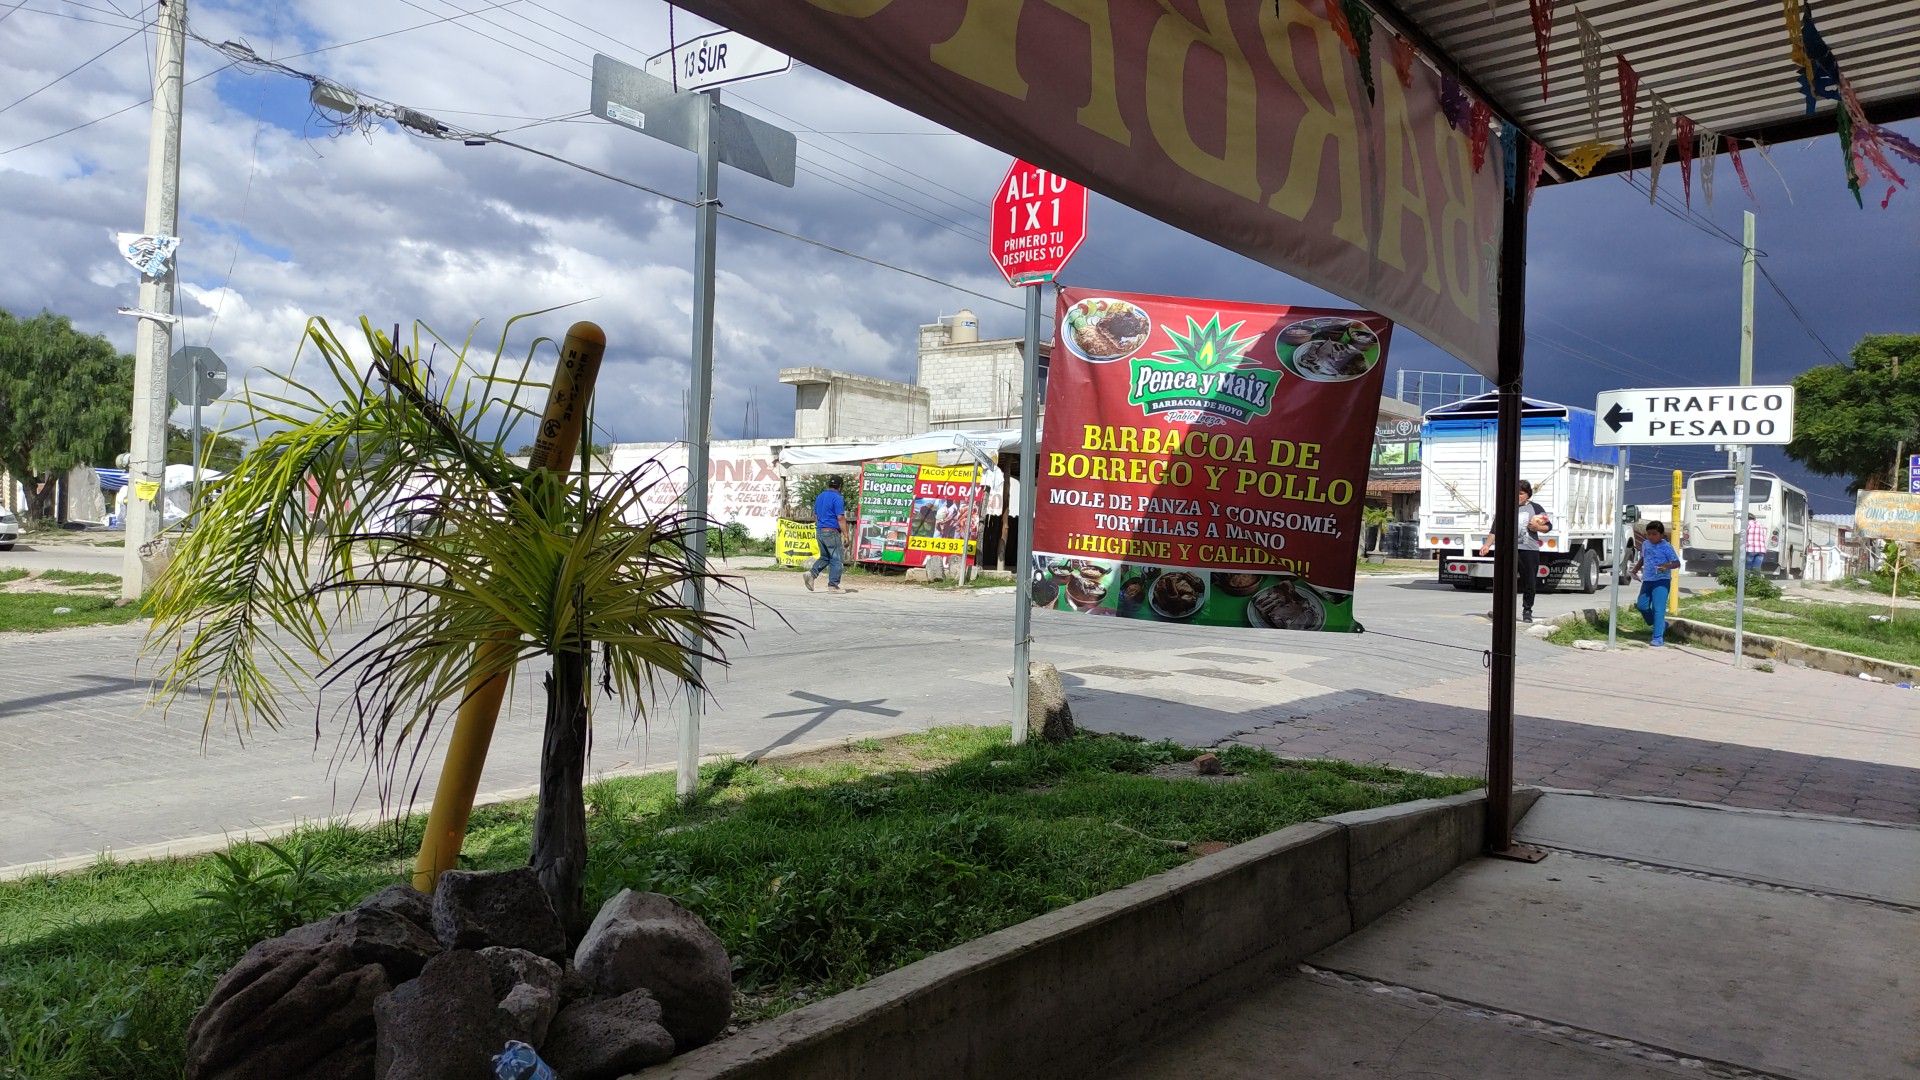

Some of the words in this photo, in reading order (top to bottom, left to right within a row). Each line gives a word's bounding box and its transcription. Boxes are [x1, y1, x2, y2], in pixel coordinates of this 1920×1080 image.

[684, 51, 695, 79] 13
[698, 43, 727, 74] SUR
[1004, 233, 1047, 252] PRIMERO
[1050, 231, 1064, 244] TU
[1002, 247, 1046, 266] DESPUES
[1049, 246, 1064, 259] YO
[1135, 366, 1197, 398] Penca
[1152, 399, 1202, 410] BARBACOA
[1203, 400, 1217, 409] DE
[1217, 403, 1243, 417] HOYO
[1645, 394, 1783, 413] TRAFICO
[1649, 419, 1775, 437] PESADO
[1081, 424, 1257, 464] BARBACOA
[1267, 439, 1321, 470] DE
[922, 468, 945, 476] TACOS
[953, 469, 982, 477] CEMIA
[1048, 453, 1193, 487] BORREGO
[1203, 465, 1228, 491] Y
[1234, 469, 1353, 506] POLLO
[863, 480, 913, 494] Elegance
[920, 483, 933, 494] EL
[1049, 488, 1105, 509] MOLE
[1109, 494, 1132, 511] DE
[1137, 496, 1202, 516] PANZA
[1208, 501, 1221, 517] Y
[1226, 505, 1342, 539] CONSOMÉ,
[1095, 513, 1199, 538] TORTILLAS
[1205, 522, 1219, 539] A
[1225, 523, 1286, 550] MANO
[785, 540, 810, 549] MEZA
[911, 539, 927, 548] 223
[931, 541, 946, 550] 143
[949, 542, 958, 551] 93
[1177, 543, 1193, 561] Y
